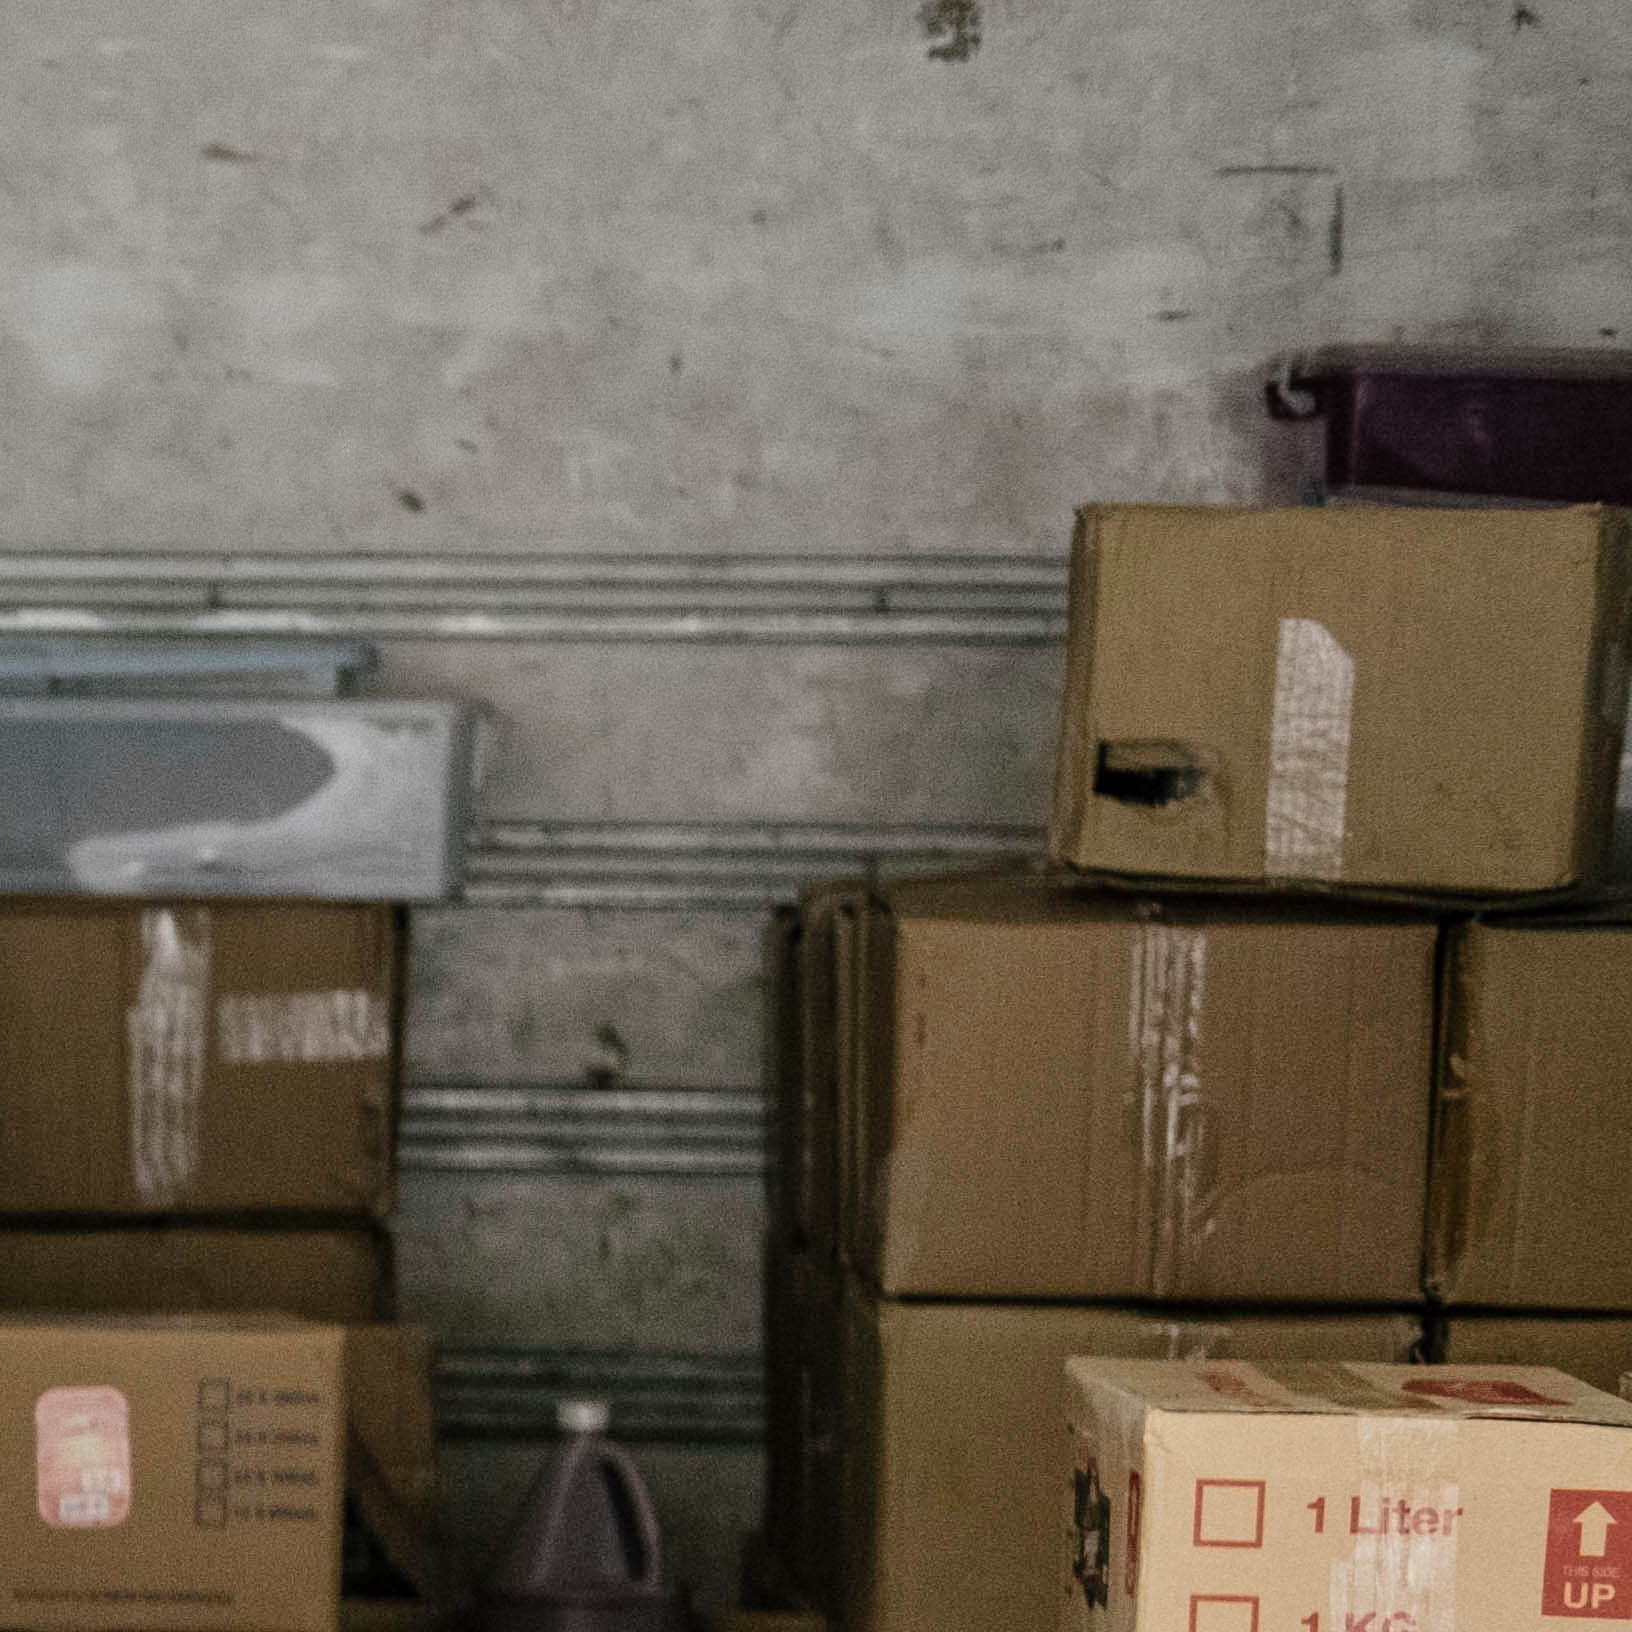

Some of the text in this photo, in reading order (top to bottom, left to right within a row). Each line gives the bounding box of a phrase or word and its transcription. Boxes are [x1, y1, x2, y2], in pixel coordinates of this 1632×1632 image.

[1306, 1495, 1465, 1537] 1 Liter
[1563, 1581, 1616, 1609] UP
